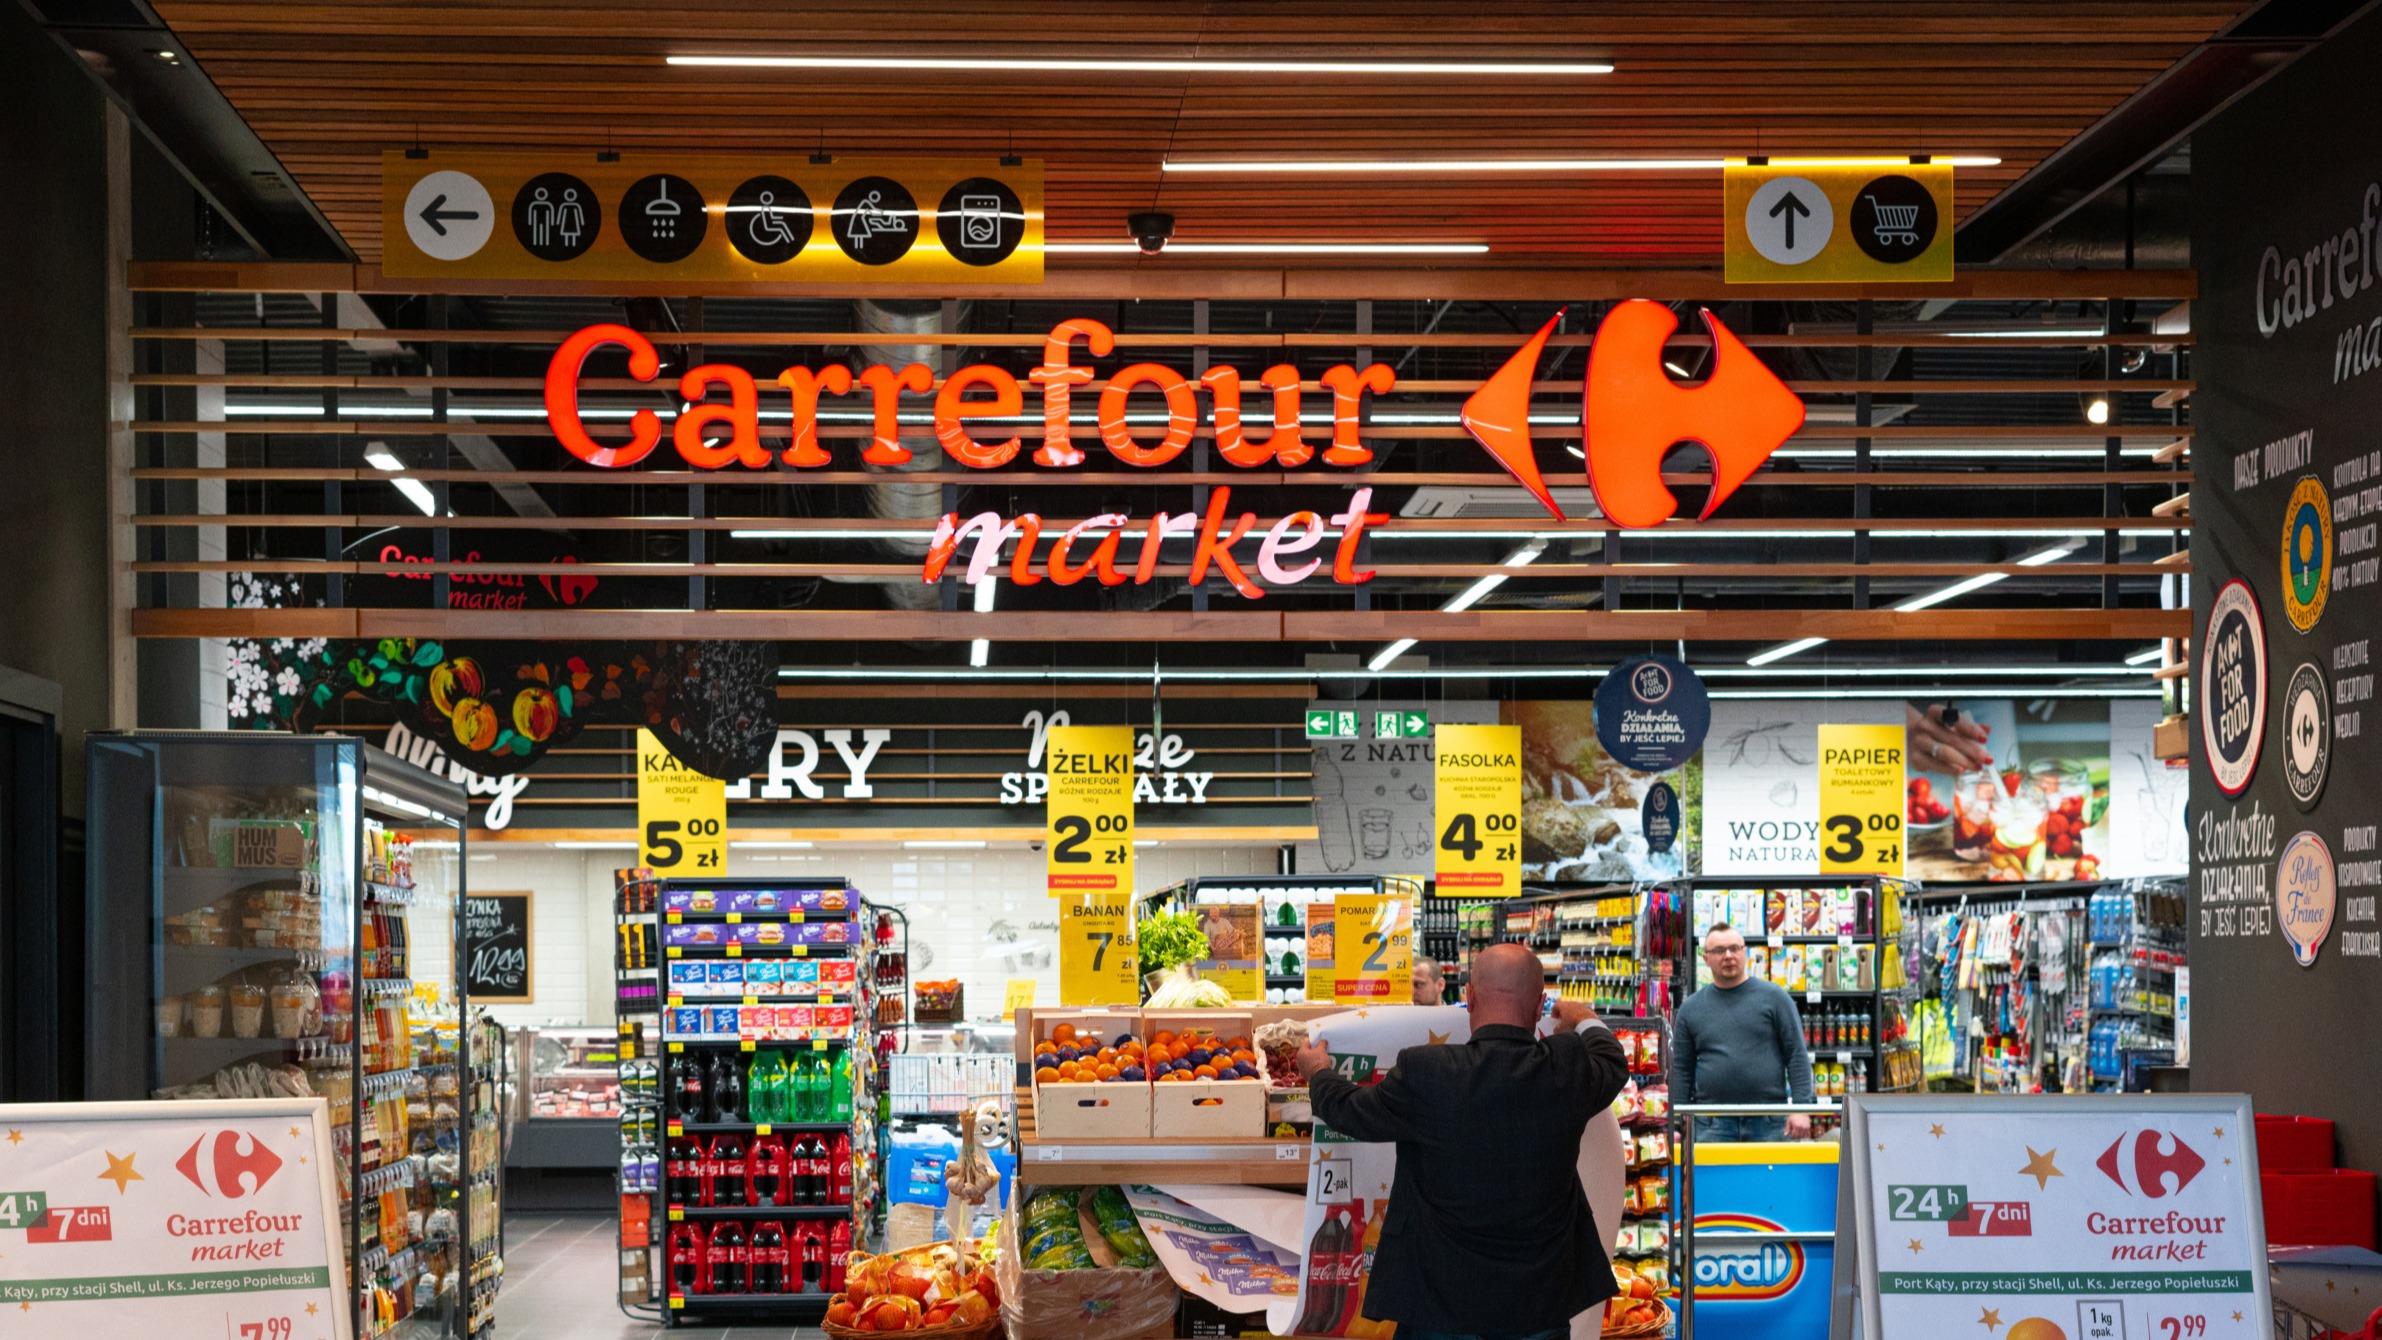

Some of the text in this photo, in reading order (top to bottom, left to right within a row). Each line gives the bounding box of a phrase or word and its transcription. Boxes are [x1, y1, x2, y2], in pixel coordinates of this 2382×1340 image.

[2256, 182, 2382, 338] Carref
[545, 318, 1397, 468] Carrefour
[2234, 428, 2313, 491] NASZE PRODUKTY
[2334, 449, 2380, 488] KONTROLA NA
[923, 485, 1391, 598] market
[2339, 522, 2377, 557] PRODUKCJI
[2351, 556, 2379, 587] NATURY
[2288, 579, 2326, 625] CARREFOUR
[1642, 684, 1664, 698] FOOD
[1643, 677, 1659, 689] FOR
[2221, 664, 2244, 711] FOR
[2336, 674, 2374, 704] RECEPTURY
[1623, 709, 1679, 723] Konkretne
[2219, 695, 2250, 750] FOOD
[1620, 734, 1631, 743] BY
[1656, 734, 1686, 744] LEPIEJ
[726, 728, 891, 799] RY
[1053, 748, 1128, 775] ŻELKI
[1341, 744, 1355, 761] Z
[1440, 754, 1516, 767] FASOLKA
[1825, 748, 1901, 765] PAPIER
[1061, 777, 1120, 785] CARREFOUR
[2288, 748, 2326, 794] CARREFOUR
[665, 786, 699, 795] ROUGE
[1000, 772, 1213, 803] SPAŁY
[238, 827, 277, 847] HUM
[645, 818, 720, 868] 5 00
[1053, 814, 1128, 863] 2 00
[1440, 813, 1517, 862] 4 00
[1729, 822, 1820, 841] WODY
[1824, 814, 1900, 864] 3 00
[2199, 800, 2276, 863] Konkretne
[2344, 826, 2377, 852] PRODUKTY
[238, 847, 277, 866] MUS
[697, 848, 719, 867] zł
[1104, 845, 1127, 864] zł
[1496, 843, 1516, 861] zł
[1877, 844, 1899, 863] zł
[1073, 905, 1125, 917] BANAN
[2286, 890, 2326, 925] France
[2200, 904, 2271, 937] BY JEŚĆ LEPIEJ
[1087, 932, 1133, 972] 7 85
[1361, 931, 1408, 972] 2 99
[1337, 984, 1388, 992] SUPER CENA
[1360, 1057, 1369, 1071] h
[25, 1196, 38, 1212] h
[1892, 1187, 1959, 1220] 24 h
[51, 1208, 109, 1240] 7 dni
[166, 1210, 303, 1237] Carrefour
[1972, 1203, 2028, 1234] 7 dni
[2086, 1210, 2226, 1235] Carrefour
[191, 1237, 285, 1262] market
[1195, 1250, 1219, 1261] Milka
[2111, 1239, 2208, 1263] market
[1217, 1267, 1246, 1277] Milka
[1677, 1246, 1772, 1282] oral
[4, 1273, 316, 1299] Kąty, przy stacji Shell, ul. Ks. Jerzego Popiełuszki
[1237, 1280, 1267, 1290] Milka
[1894, 1276, 2239, 1292] Port Kąty, przy stacji Shell, ul. Ks. Jerzego Popiełuszki
[267, 1316, 292, 1340] 99
[2090, 1308, 2112, 1326] 1 kg
[2184, 1314, 2207, 1337] 99
[2090, 1327, 2113, 1339] opak.
